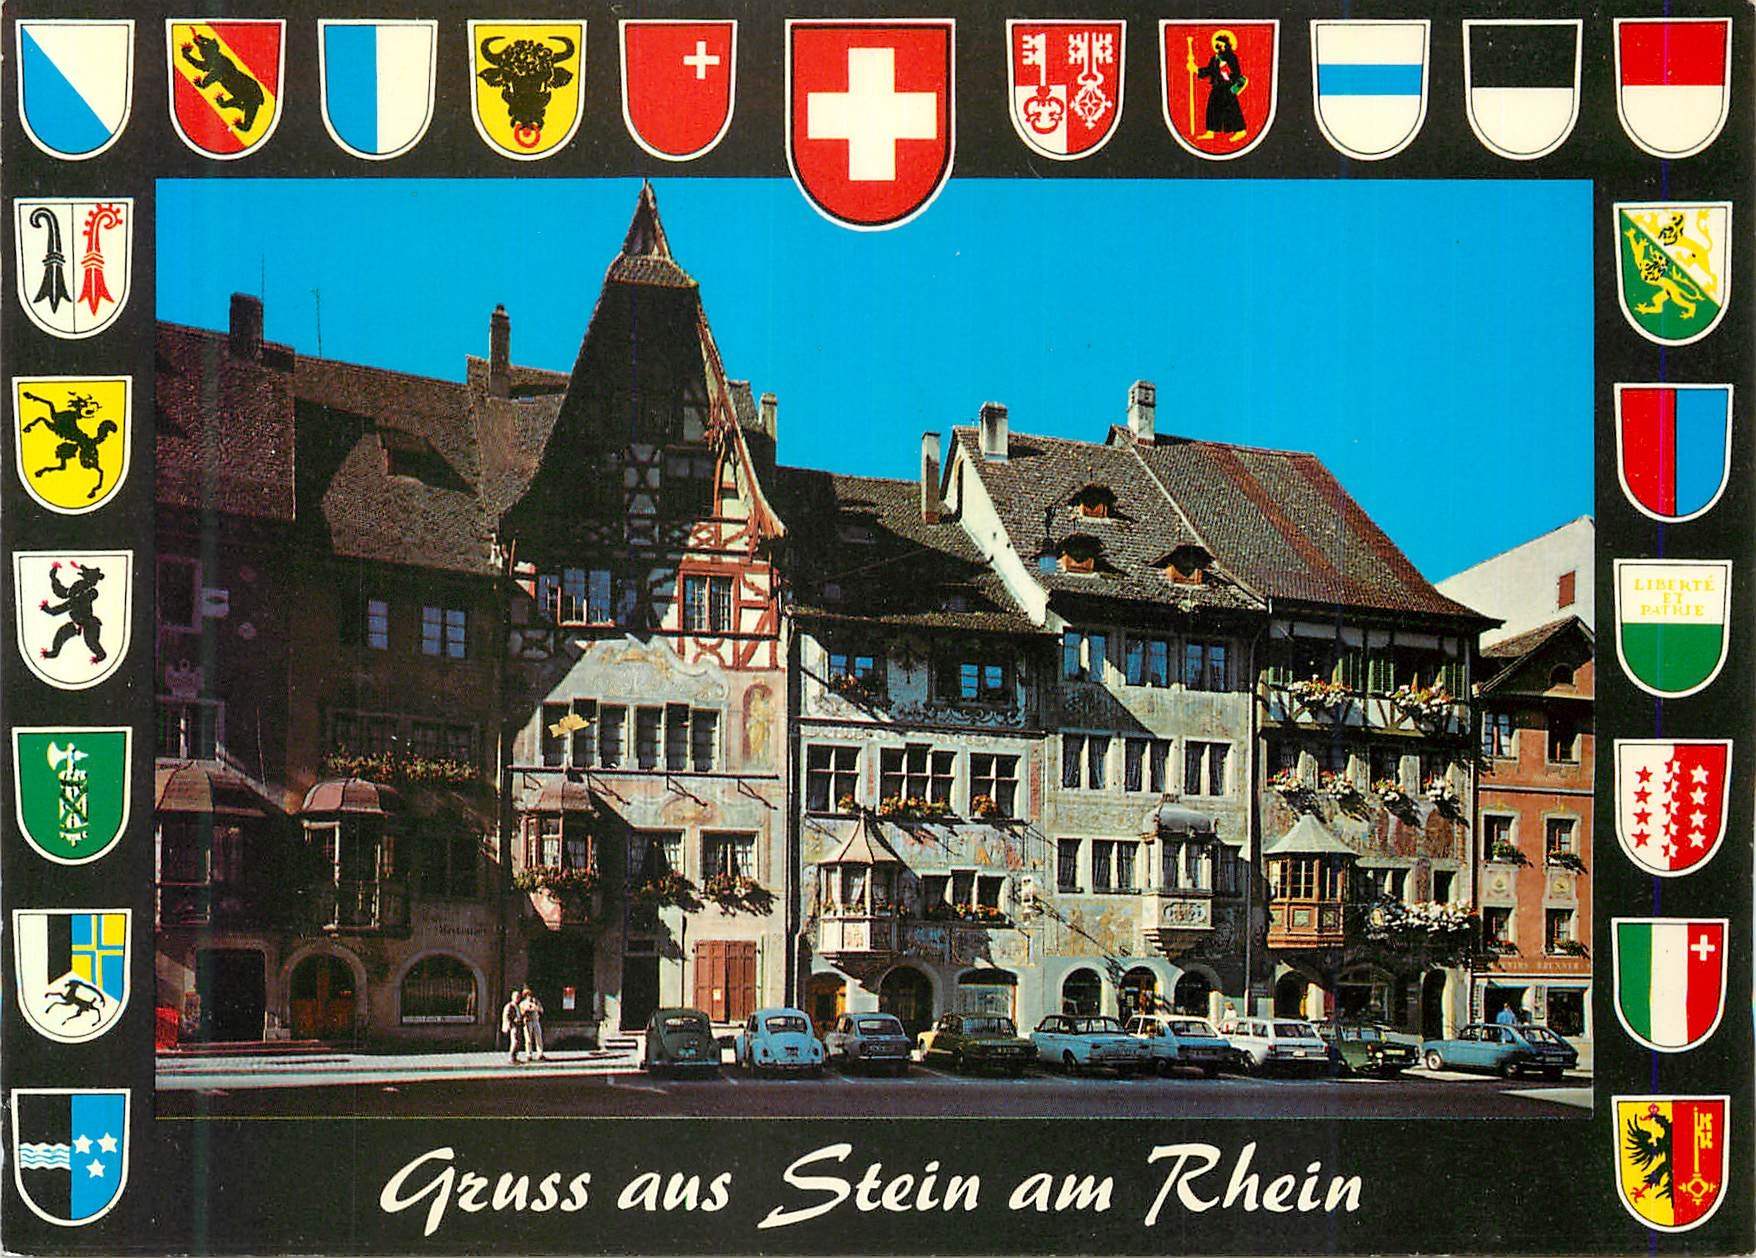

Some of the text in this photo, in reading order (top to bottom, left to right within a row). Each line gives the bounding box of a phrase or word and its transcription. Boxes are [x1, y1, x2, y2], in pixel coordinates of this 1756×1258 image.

[1633, 574, 1715, 592] LIBERTÉ
[1662, 592, 1683, 604] ET
[1640, 604, 1704, 617] PATRIE
